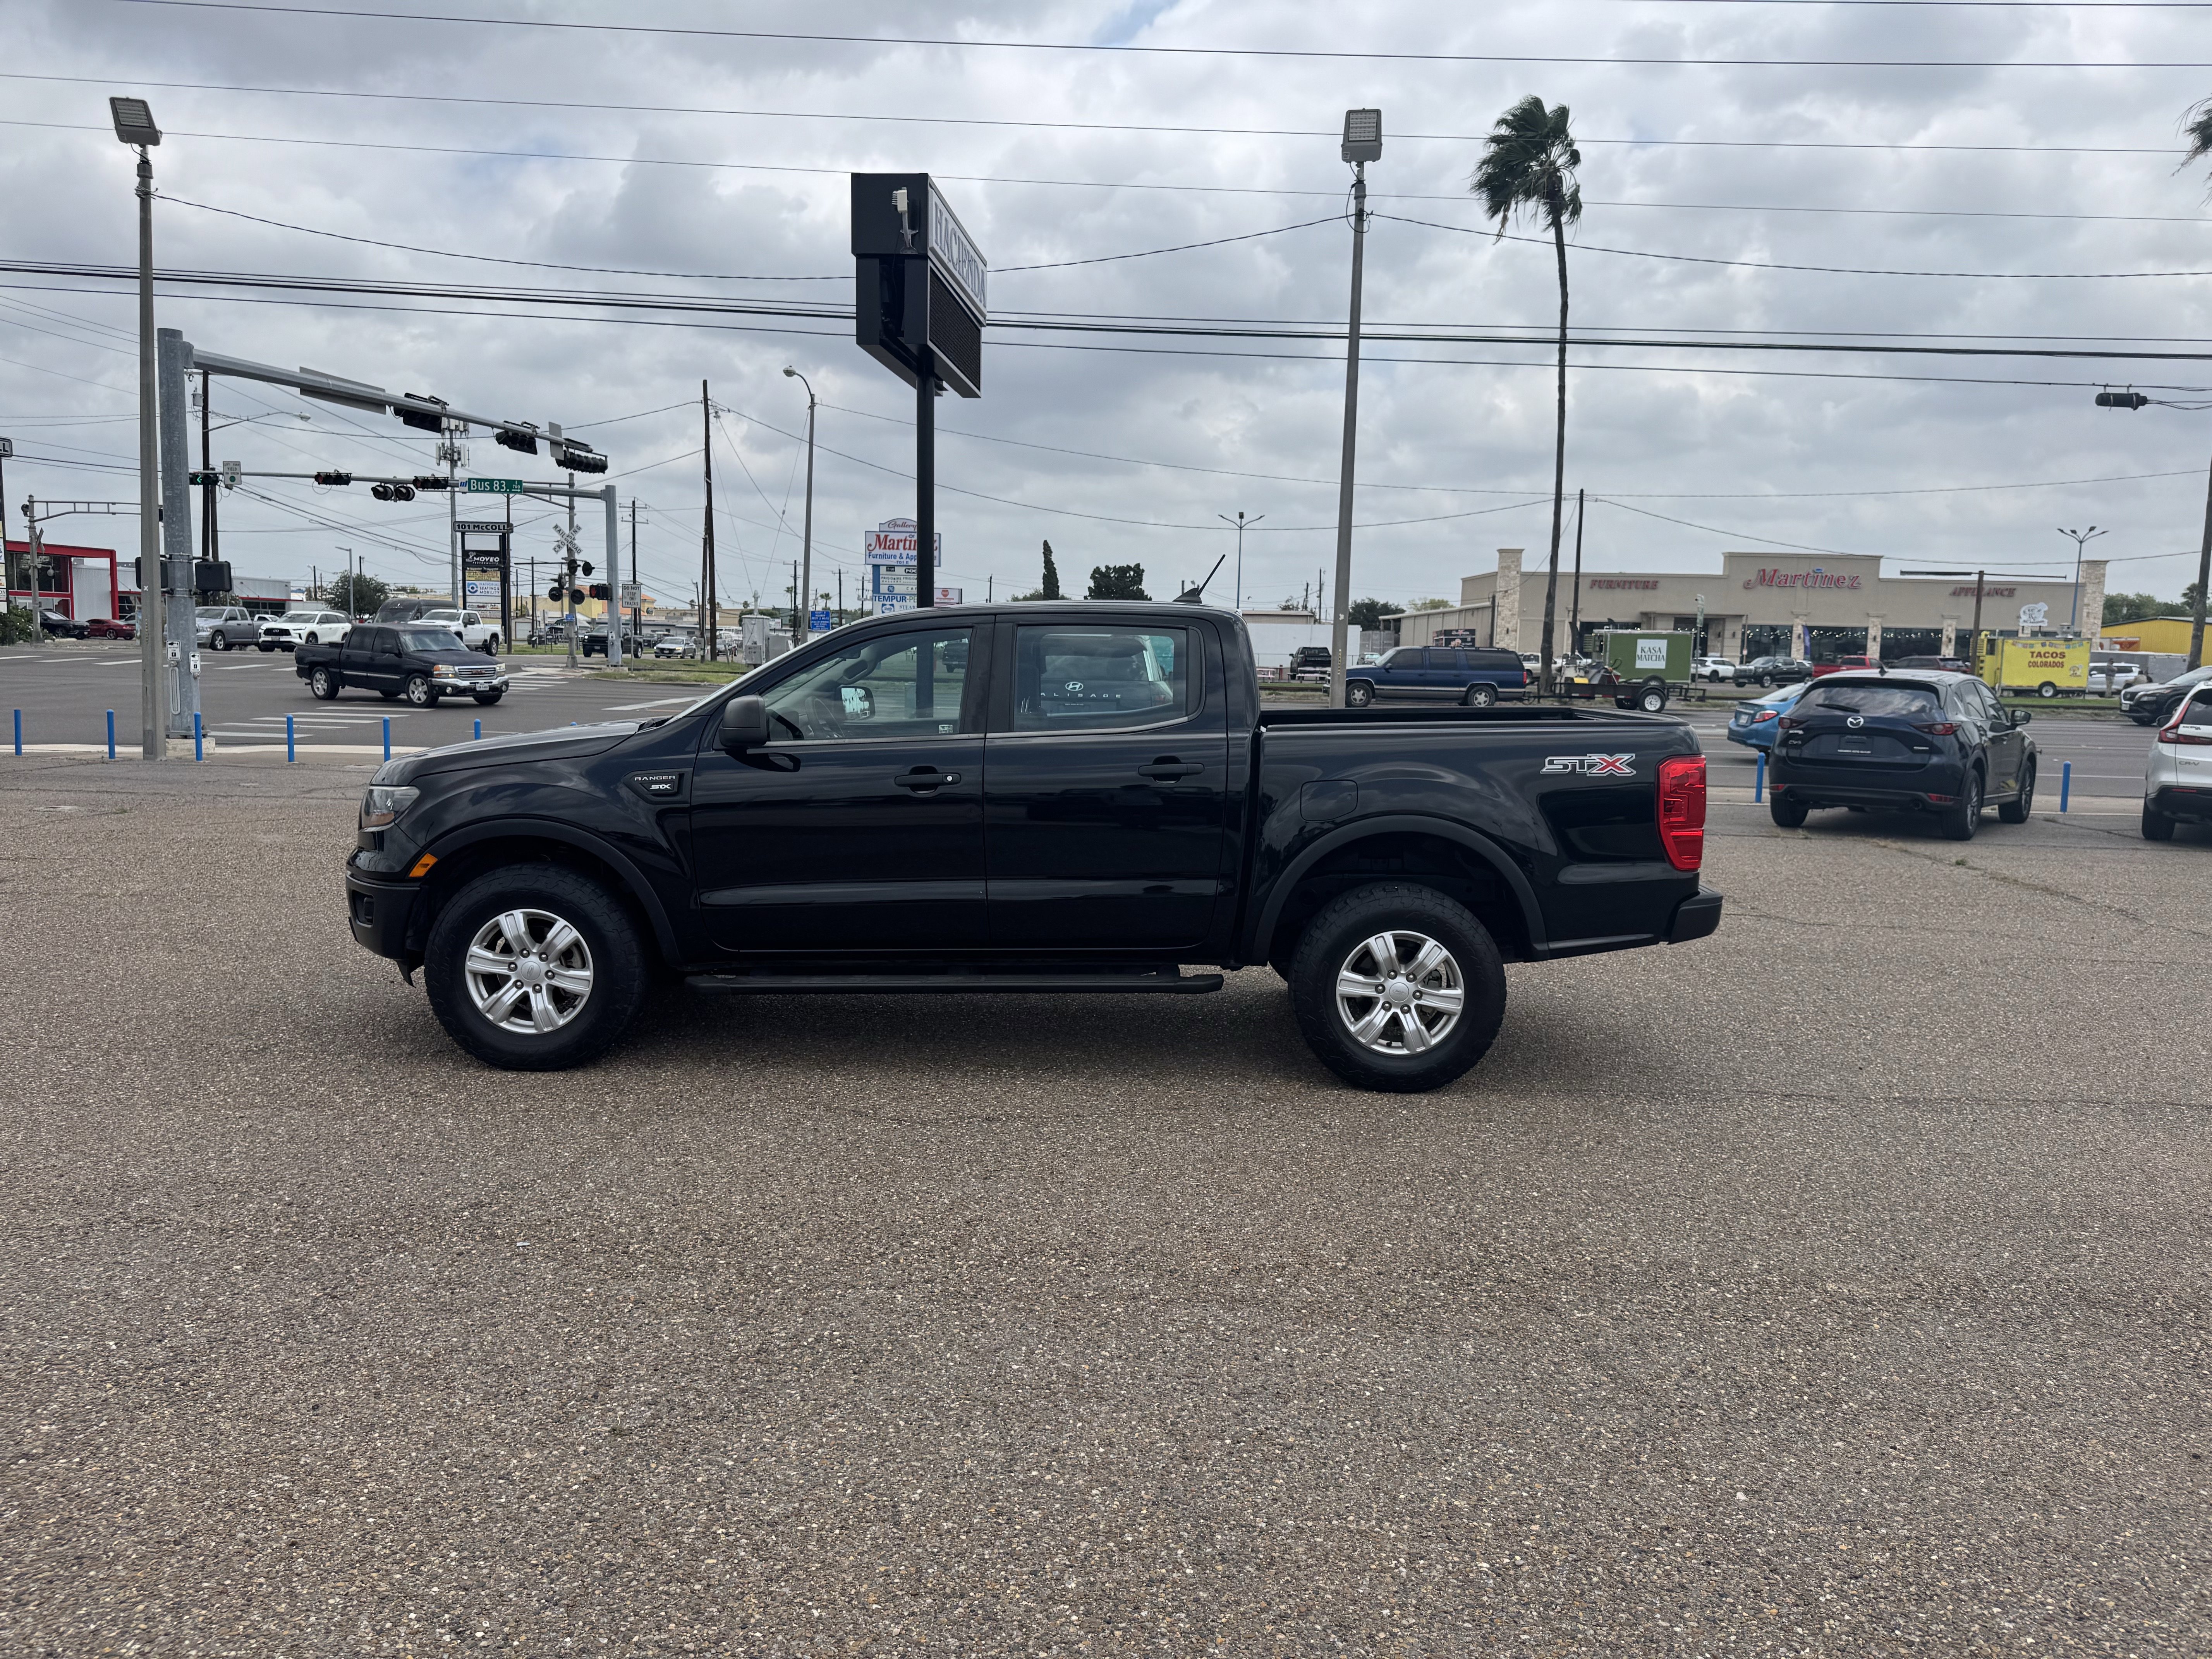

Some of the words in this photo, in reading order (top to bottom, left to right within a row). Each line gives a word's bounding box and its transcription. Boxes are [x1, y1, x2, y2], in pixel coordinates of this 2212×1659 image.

[934, 201, 987, 309] HACIENDA
[471, 479, 490, 491] Bus
[493, 481, 510, 491] 83.
[888, 521, 917, 531] Gallery
[867, 534, 938, 552] Martiz
[1590, 579, 1659, 589] FURNITURE
[1743, 567, 1862, 589] Martinez
[1949, 587, 2016, 597] APPLANCE
[2030, 651, 2066, 659] TACOS
[1540, 754, 1637, 776] STX
